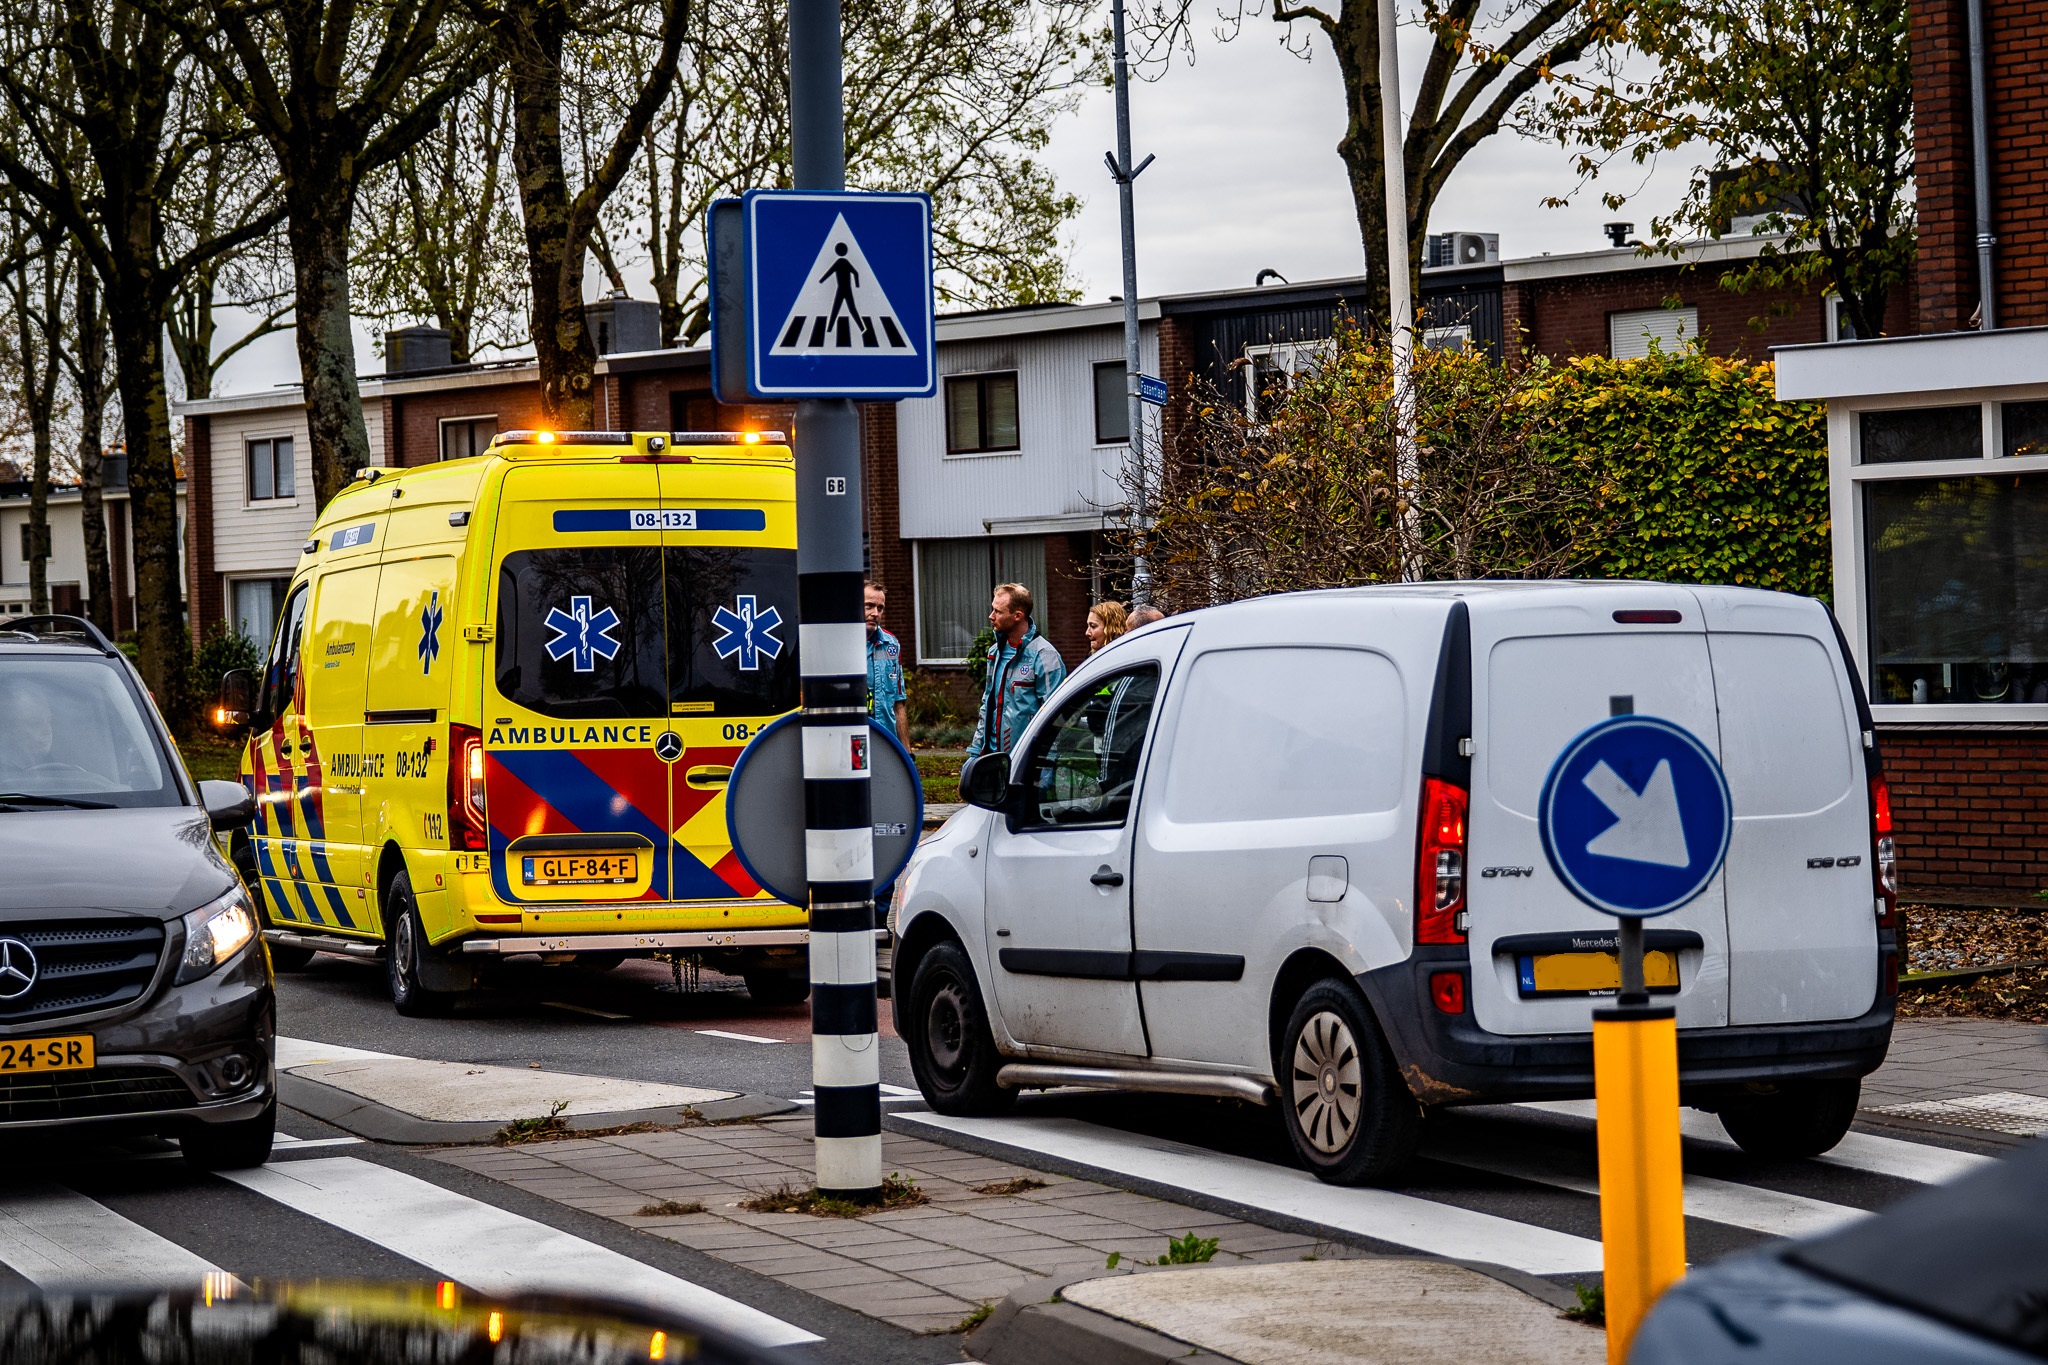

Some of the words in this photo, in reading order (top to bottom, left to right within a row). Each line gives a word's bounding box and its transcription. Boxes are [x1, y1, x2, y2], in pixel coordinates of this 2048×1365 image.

[635, 513, 692, 527] 08-132
[488, 726, 651, 745] AMBULANCE
[722, 723, 766, 740] 08-
[330, 753, 384, 778] AMBULANCE
[396, 751, 429, 778] 08-132
[543, 858, 629, 877] GLF-84-F
[1523, 977, 1533, 985] NL
[1, 1041, 83, 1069] 24-SR
